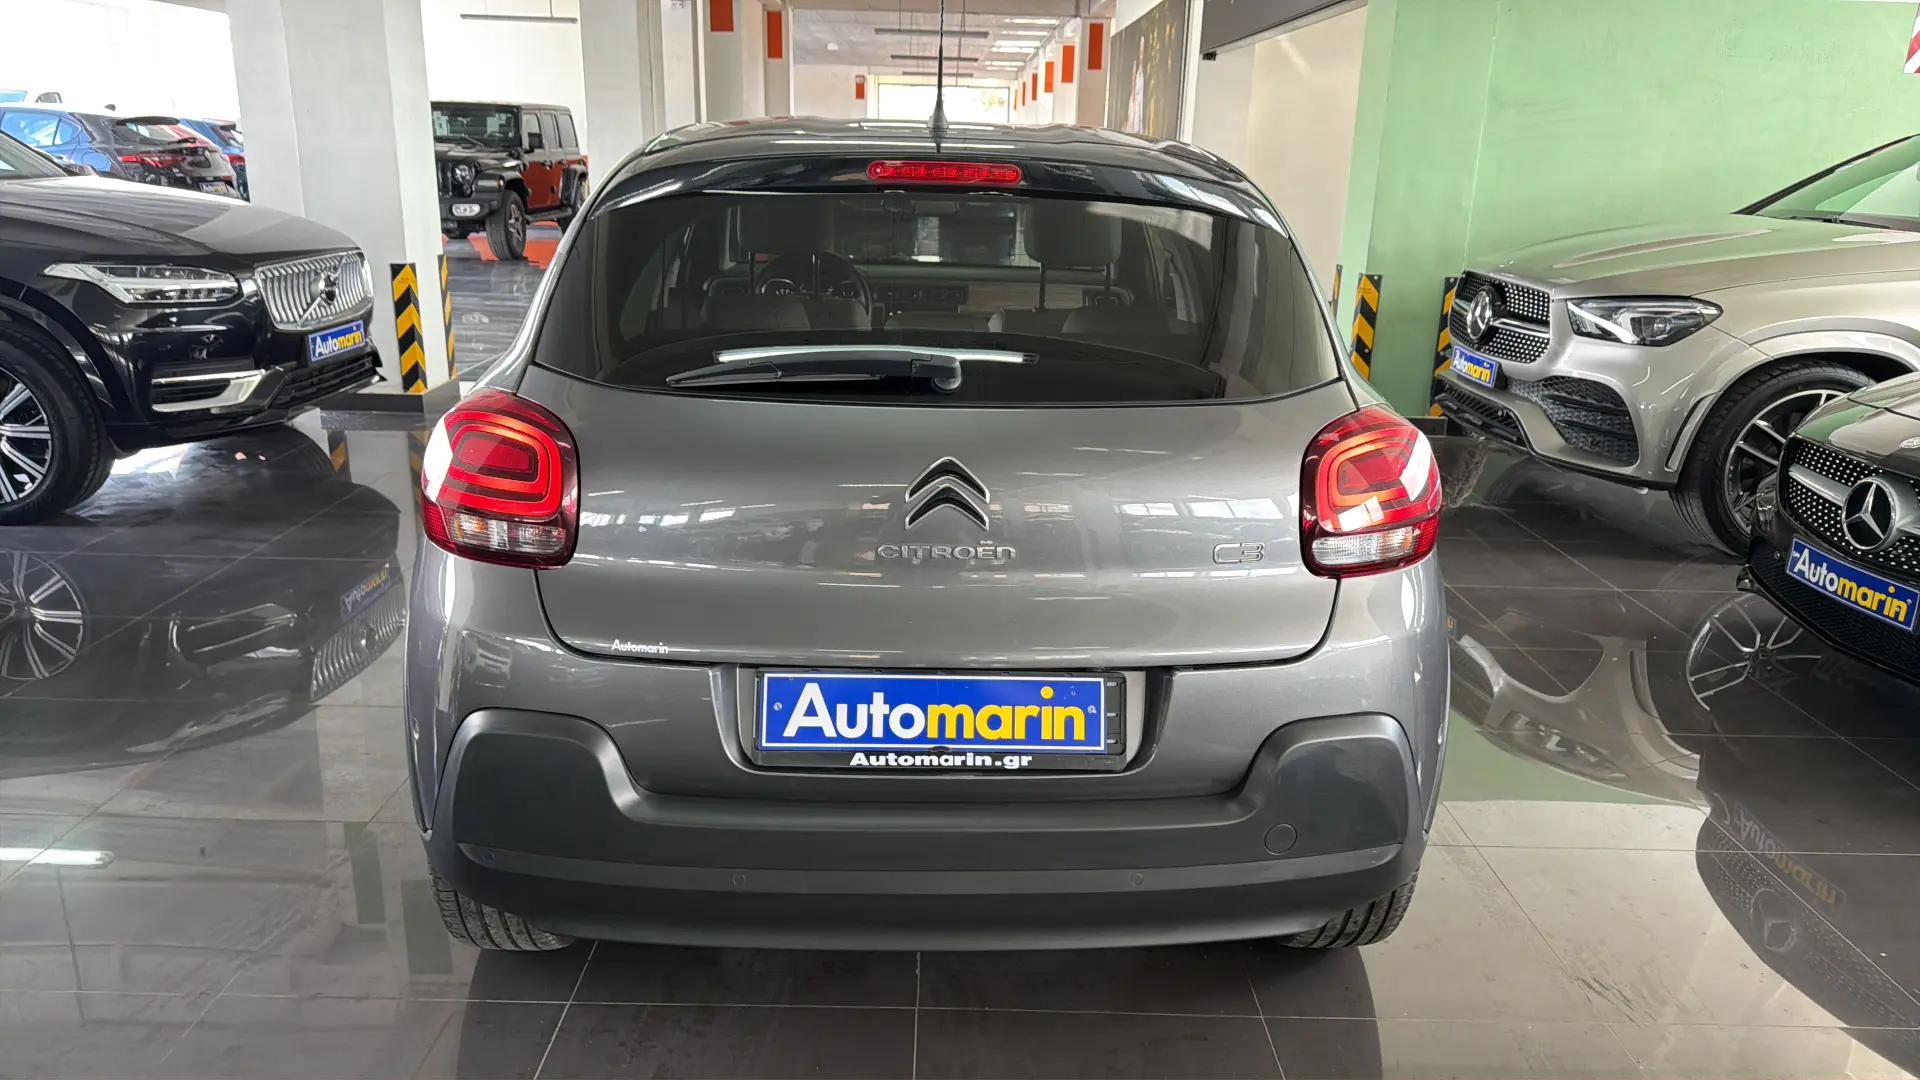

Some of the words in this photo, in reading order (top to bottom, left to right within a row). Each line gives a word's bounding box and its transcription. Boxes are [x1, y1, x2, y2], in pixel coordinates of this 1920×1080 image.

[315, 325, 363, 357] Automarin
[1212, 542, 1265, 564] C3
[1793, 547, 1908, 622] Automarin
[611, 639, 669, 654] Automarin
[782, 682, 1085, 741] Automarin
[850, 752, 1032, 769] Automarin.gr
